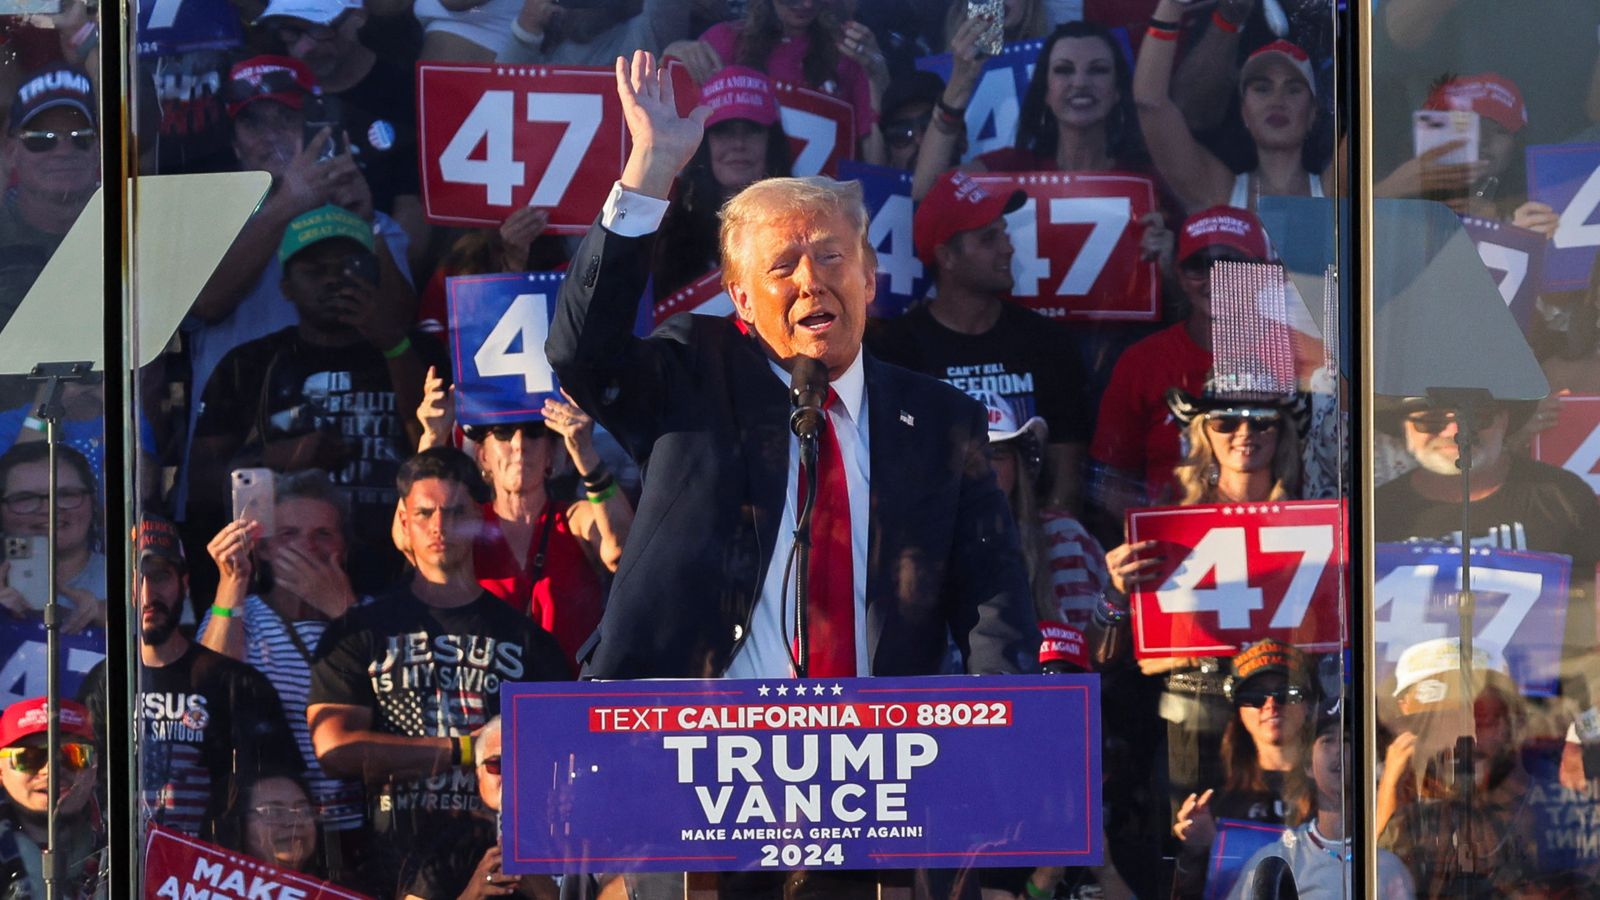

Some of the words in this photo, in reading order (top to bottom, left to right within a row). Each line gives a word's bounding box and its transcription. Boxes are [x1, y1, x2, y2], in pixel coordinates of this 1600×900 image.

[18, 70, 90, 104] TRUMP
[964, 65, 1034, 163] 4
[439, 90, 603, 207] 47
[780, 105, 838, 178] 7
[867, 195, 937, 298] 4
[1477, 241, 1529, 307] 7
[474, 293, 554, 394] 4
[938, 372, 1034, 395] EEDOM
[1155, 524, 1334, 630] 47
[368, 631, 524, 679] JESUS
[371, 673, 394, 694] IS
[402, 661, 435, 689] MY
[439, 665, 499, 695] SAVIO
[595, 708, 668, 731] TEXT
[678, 704, 860, 730] CALIFORNIA
[868, 704, 908, 727] TO
[916, 702, 1007, 726] 88022
[663, 732, 939, 783] TRUMP
[695, 783, 908, 825] VANCE
[681, 827, 727, 841] MAKE
[731, 826, 803, 840] AMERICA
[808, 826, 863, 839] GREAT
[866, 825, 924, 838] AGAIN!
[760, 844, 845, 867] 2024
